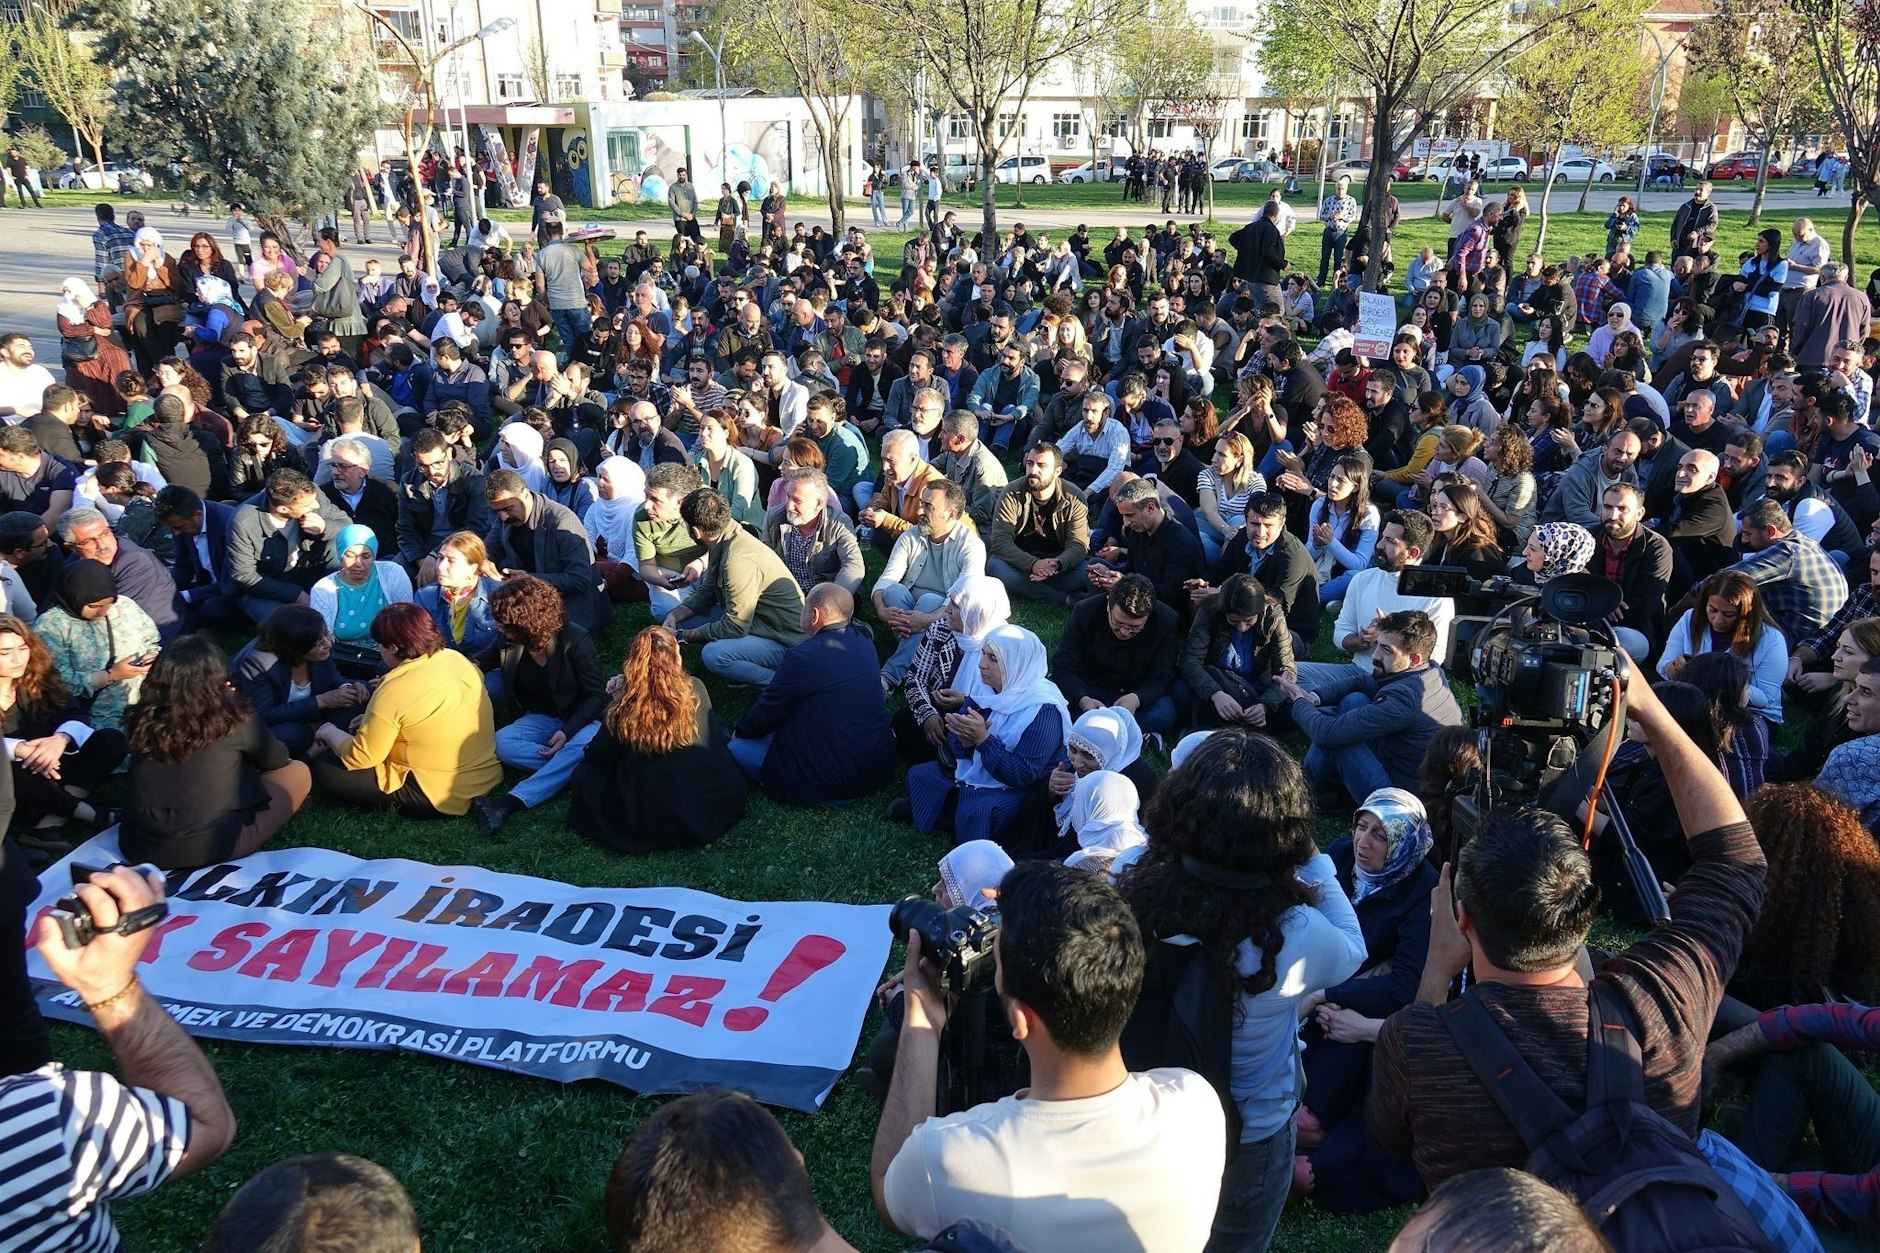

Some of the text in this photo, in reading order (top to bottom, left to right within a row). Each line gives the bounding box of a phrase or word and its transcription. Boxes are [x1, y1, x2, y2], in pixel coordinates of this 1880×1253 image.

[164, 865, 763, 962] LKIN İRADESİ
[186, 923, 847, 1032] SAYILAMAZ!
[230, 1010, 278, 1029] VE
[271, 1012, 464, 1056] DEMOKRASİ
[457, 1036, 651, 1070] PLATFORMU
